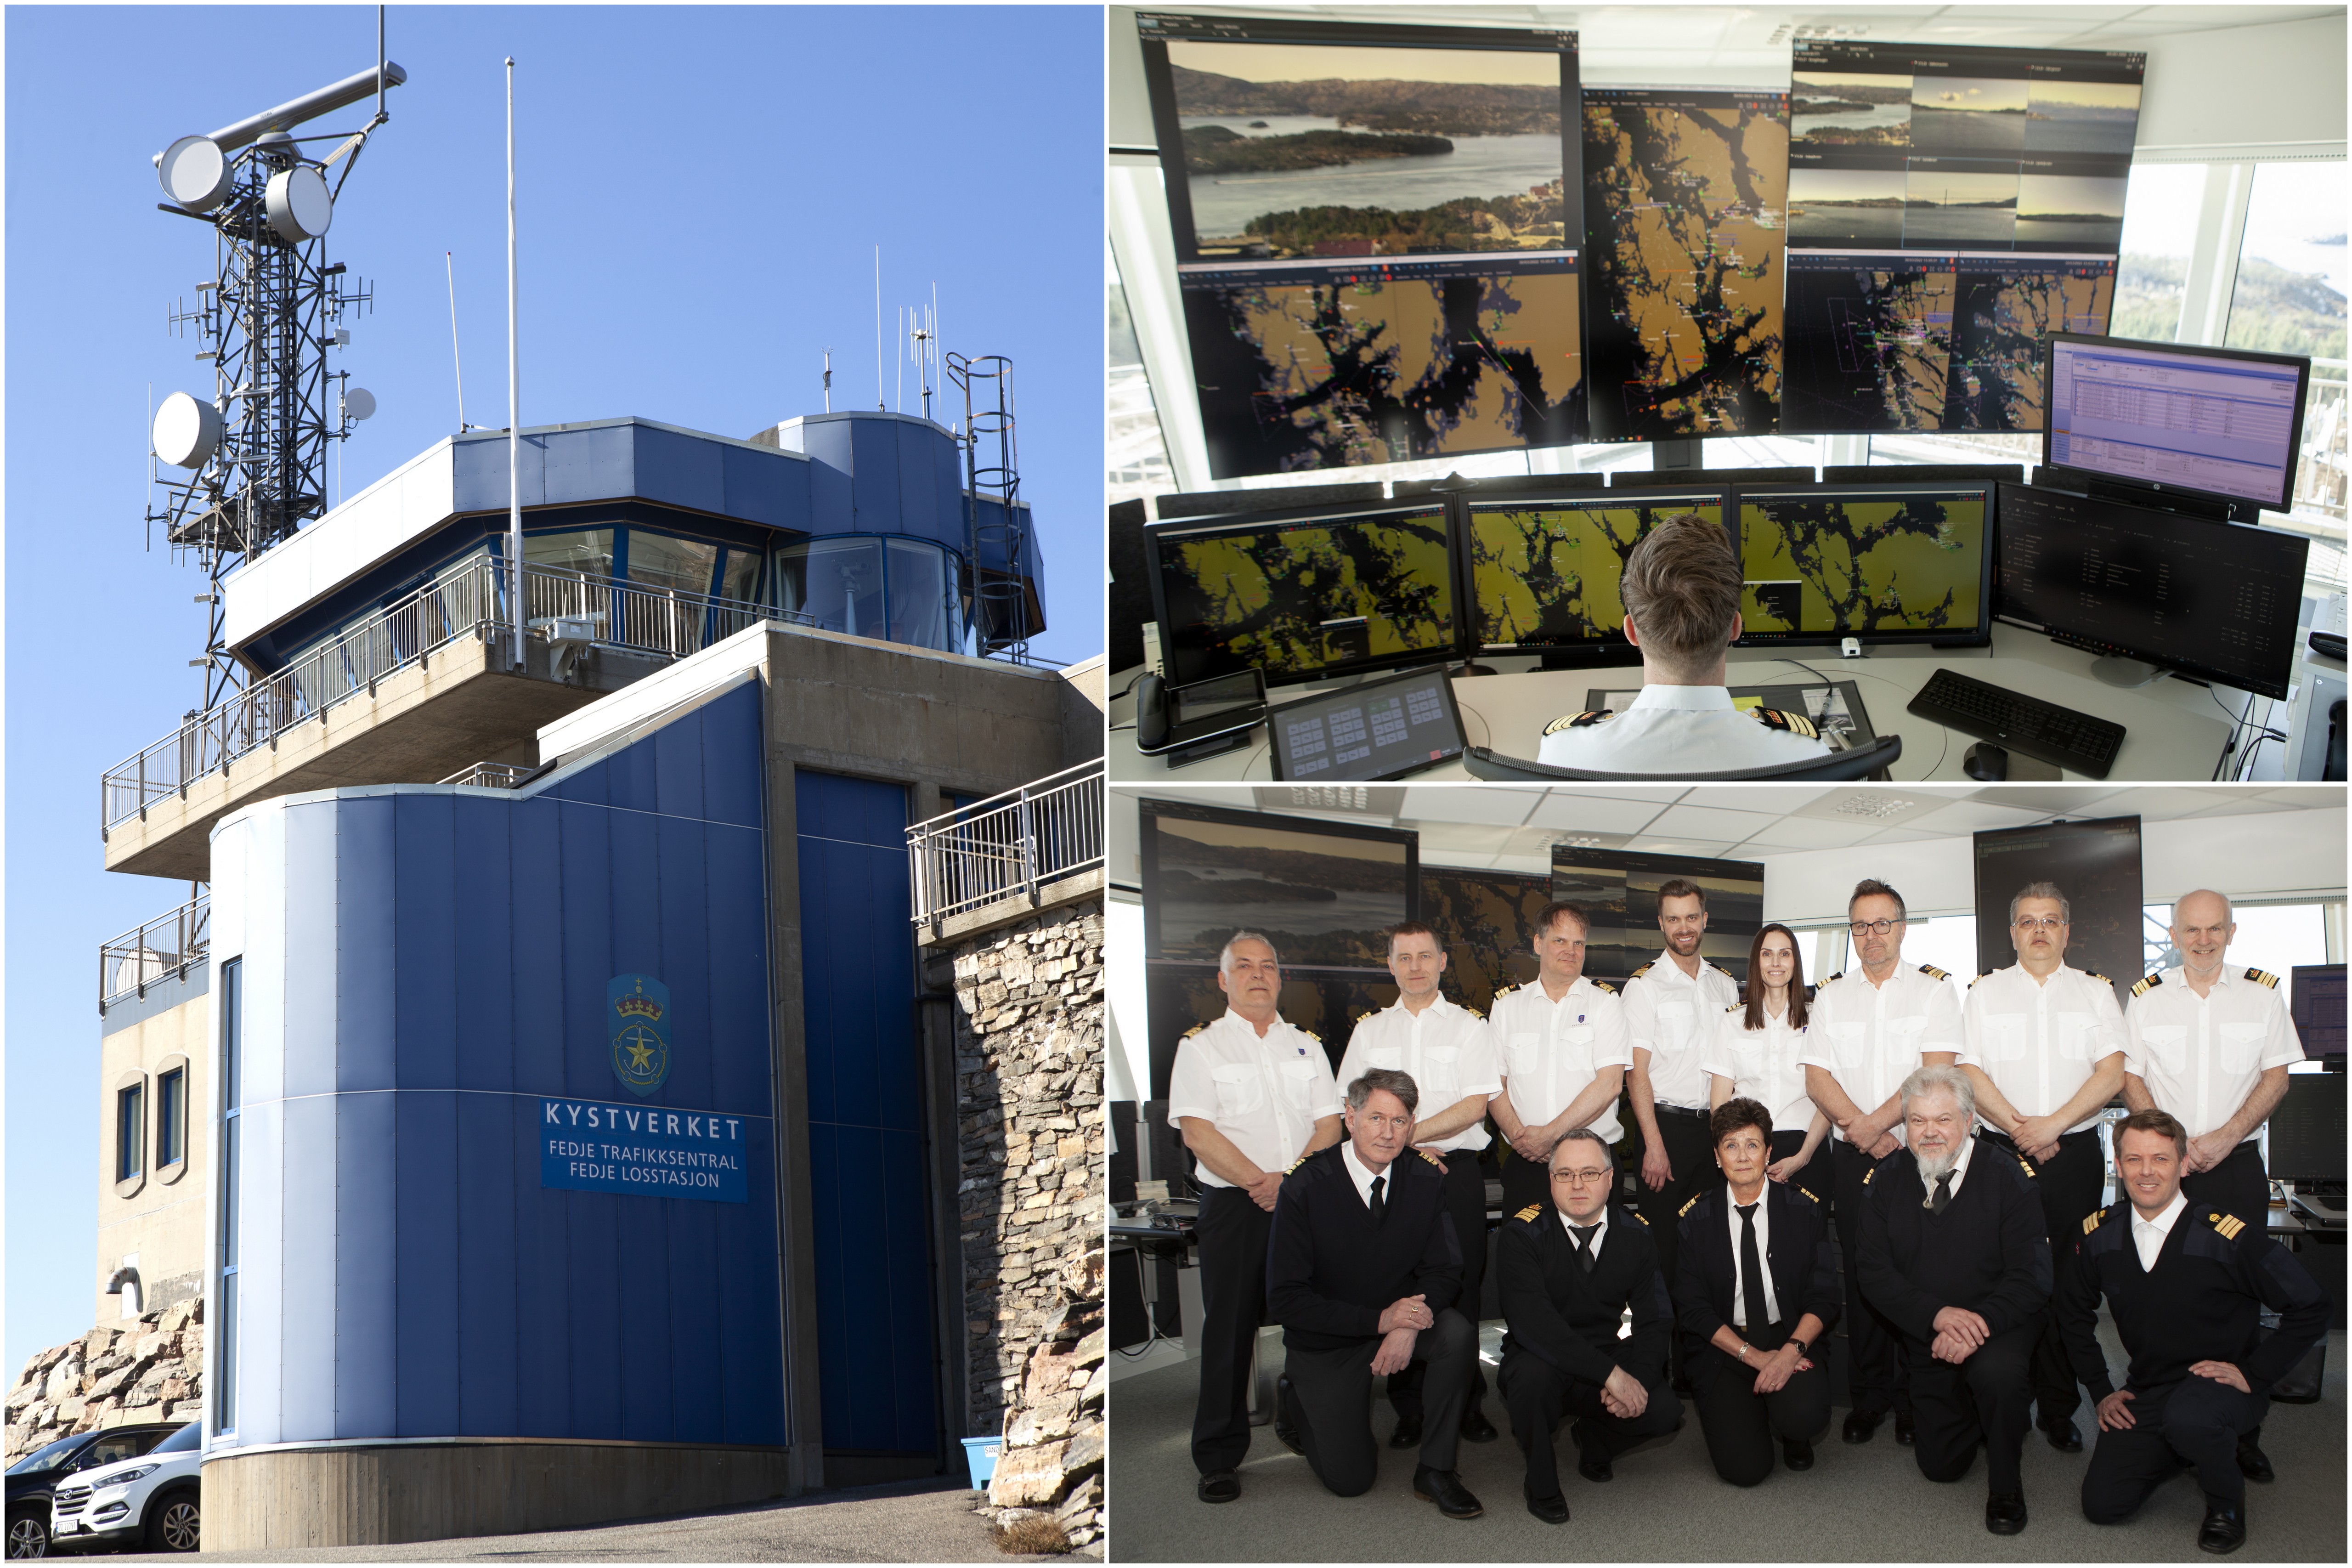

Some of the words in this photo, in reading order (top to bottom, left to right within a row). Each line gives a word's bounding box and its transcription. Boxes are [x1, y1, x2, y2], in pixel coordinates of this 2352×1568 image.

[546, 1103, 739, 1140] KYSTVERKET
[550, 1140, 595, 1158] FEDJE
[601, 1144, 738, 1170] TRAFIKKSENTRAL
[571, 1162, 615, 1179] FEDJE
[622, 1166, 719, 1188] LOSSTASJON
[64, 1522, 75, 1531] 22791
